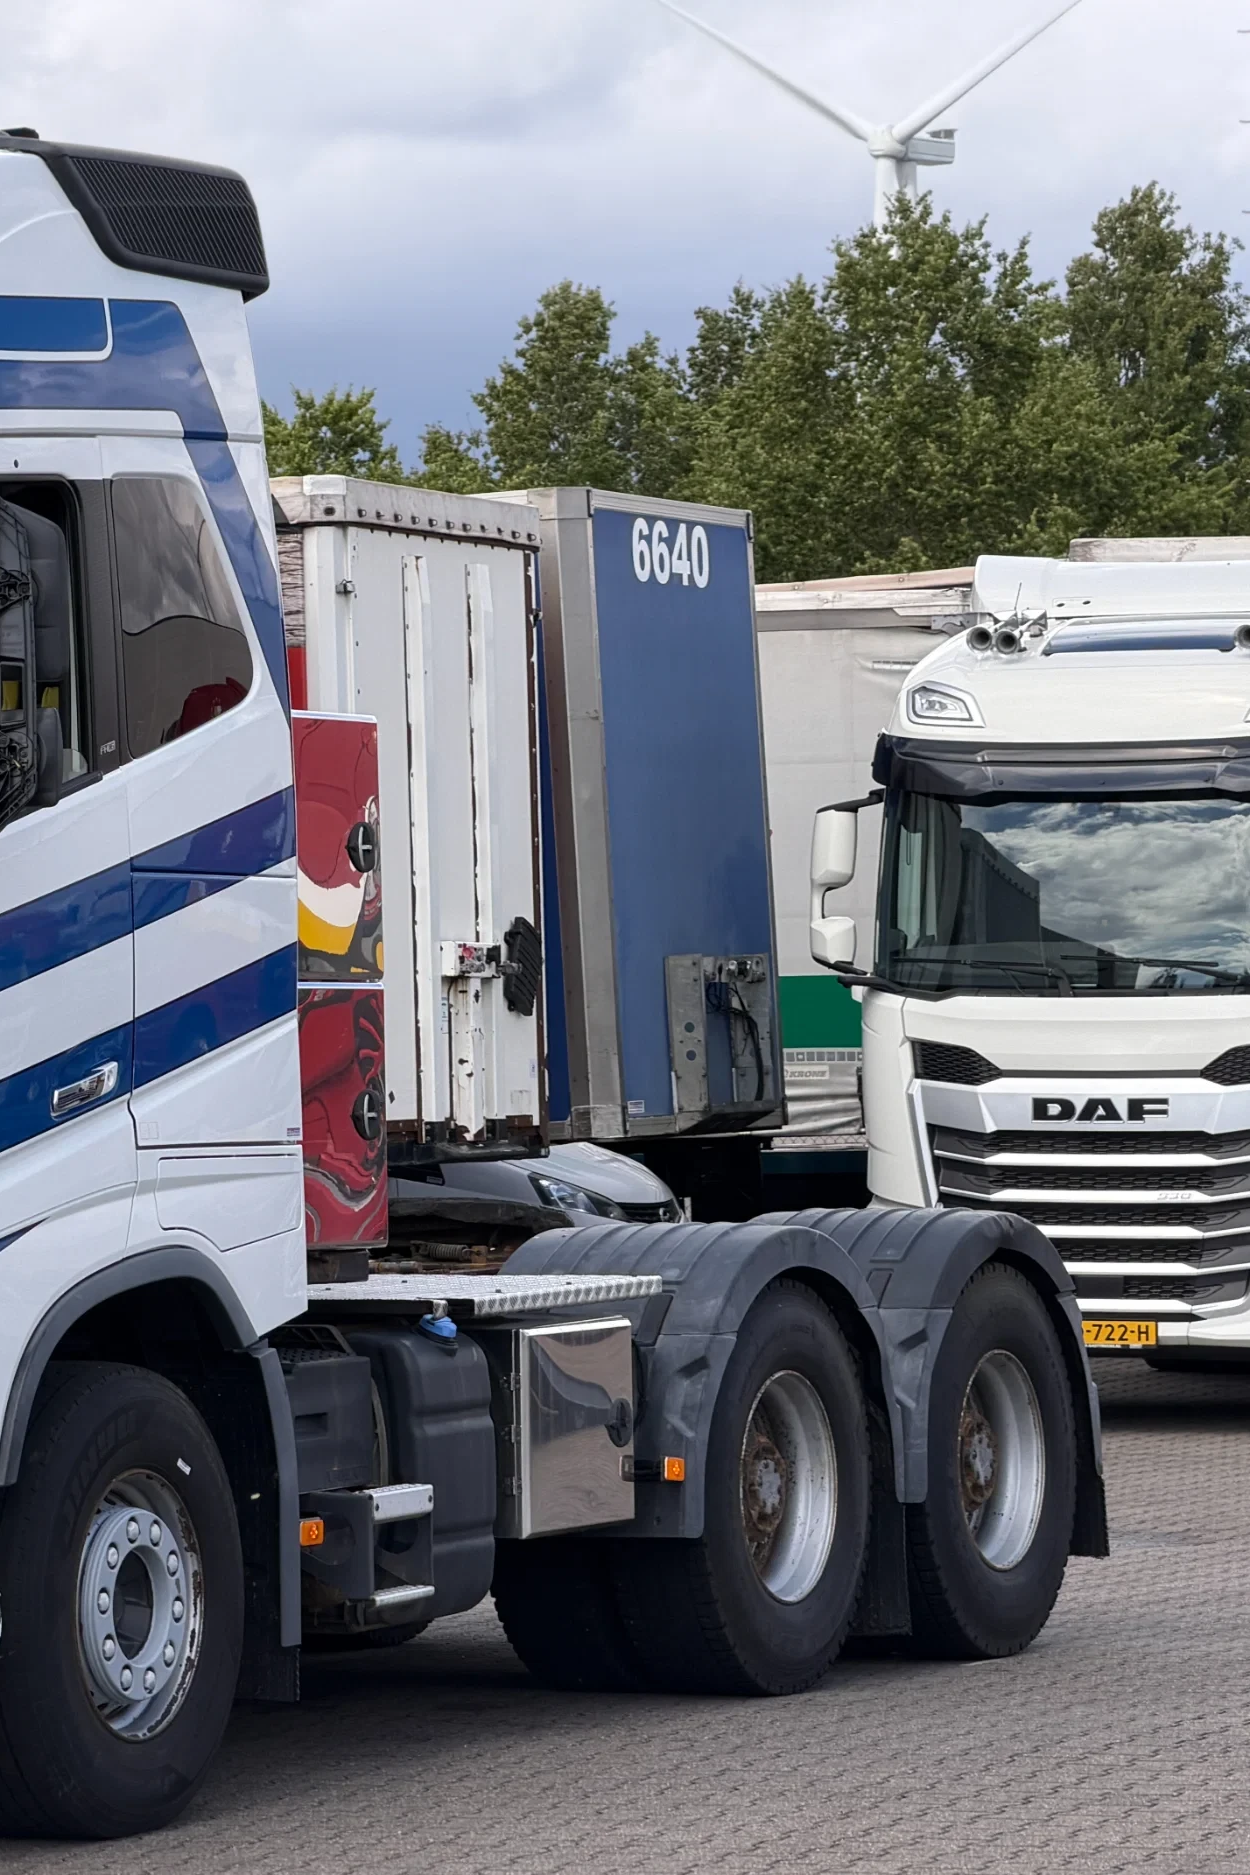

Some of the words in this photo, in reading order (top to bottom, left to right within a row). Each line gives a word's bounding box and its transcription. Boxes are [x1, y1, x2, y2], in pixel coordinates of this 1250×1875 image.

[632, 517, 710, 589] 6640
[1031, 1097, 1170, 1124] DAF
[1081, 1323, 1150, 1342] -722-H
